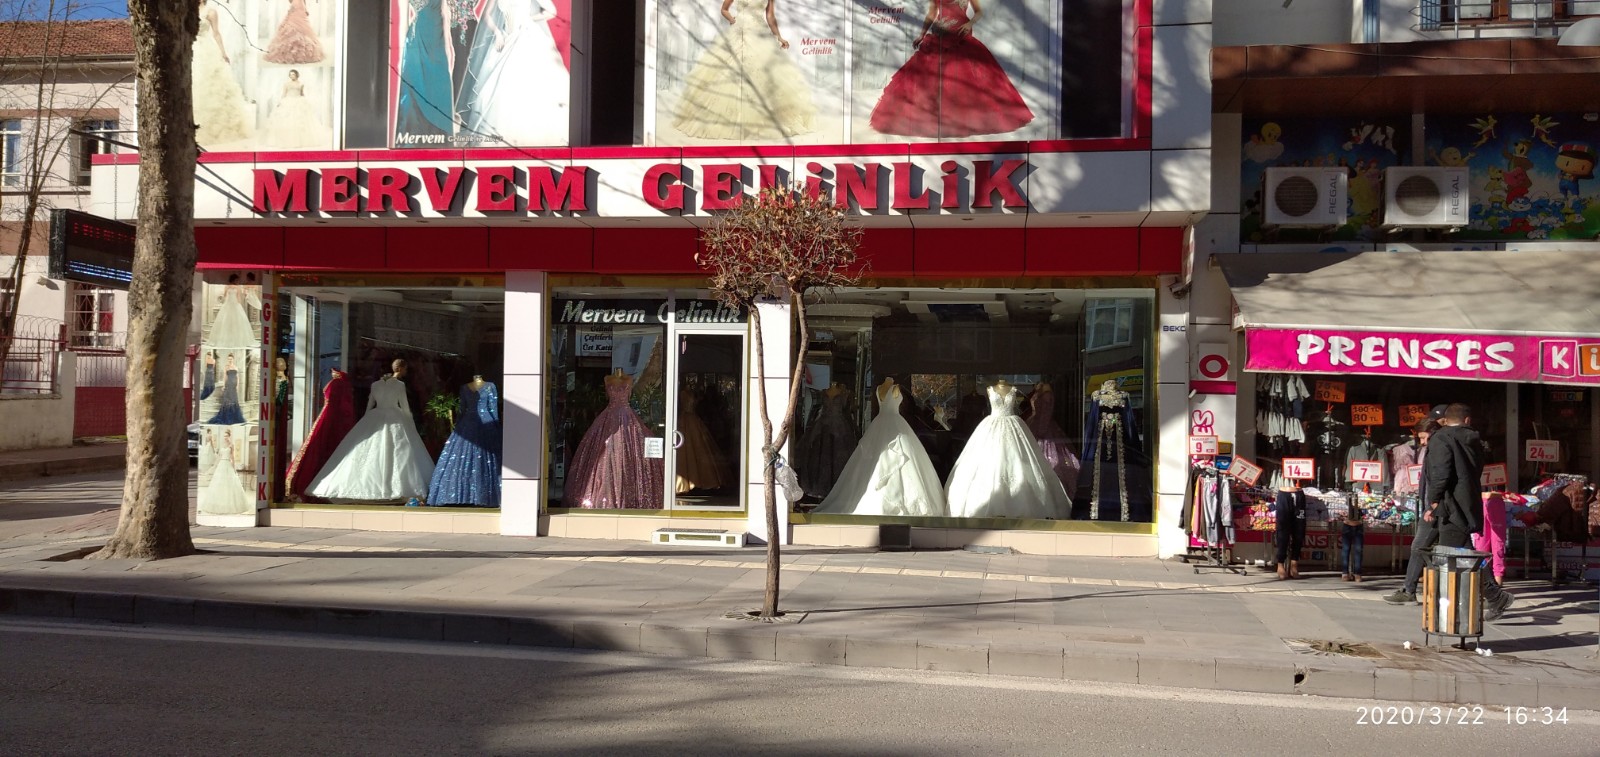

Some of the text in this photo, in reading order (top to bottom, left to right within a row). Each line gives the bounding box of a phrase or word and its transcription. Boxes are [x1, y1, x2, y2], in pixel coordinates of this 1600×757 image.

[800, 37, 836, 46] Mervem
[396, 132, 445, 144] Mervem
[253, 165, 589, 212] MERVEM
[1328, 175, 1338, 215] REGAL
[1451, 175, 1460, 216] REGAL
[560, 300, 645, 323] Mervem
[1296, 333, 1515, 372] PRENSES
[1353, 413, 1368, 422] 80
[1195, 442, 1203, 453] 9
[1530, 446, 1545, 459] 24
[1237, 465, 1247, 477] 7
[1287, 464, 1301, 477] 14
[1360, 467, 1368, 479] 7
[1483, 472, 1491, 484] 7
